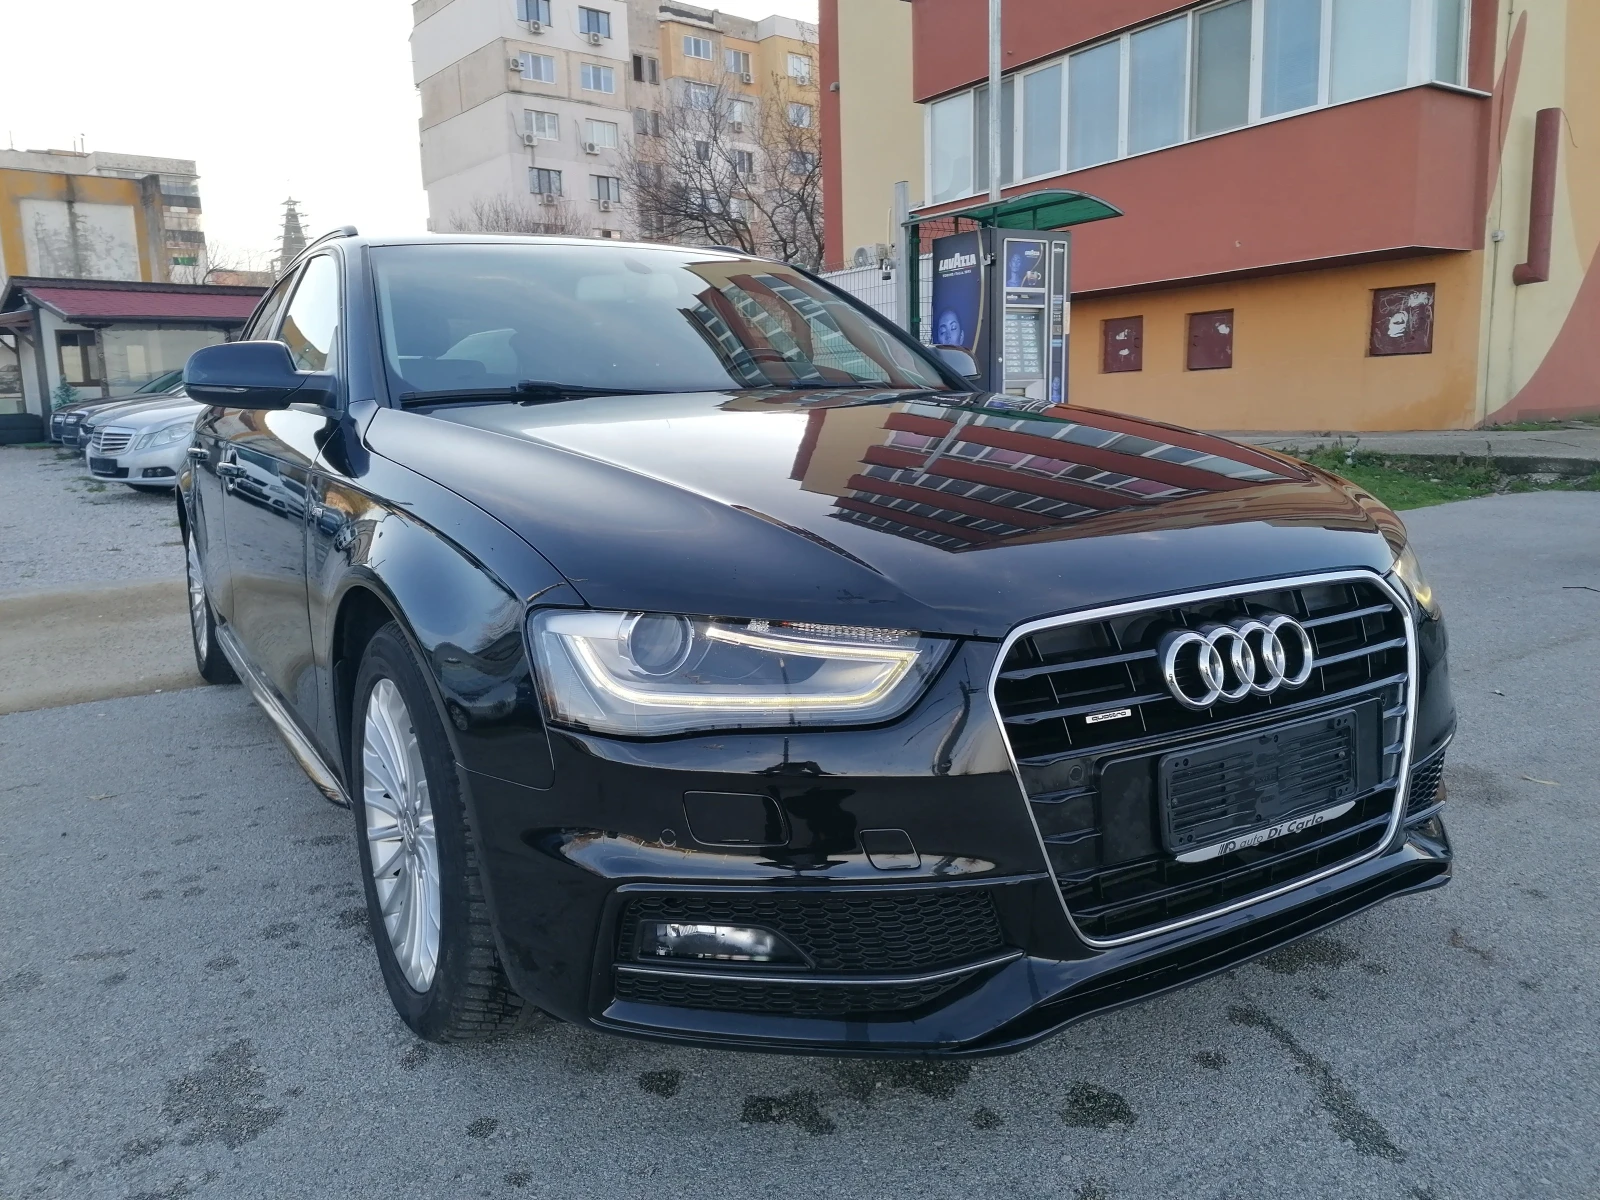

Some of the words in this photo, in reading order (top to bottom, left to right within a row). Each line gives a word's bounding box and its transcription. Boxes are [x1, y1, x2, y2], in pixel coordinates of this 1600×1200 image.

[938, 252, 977, 271] LAVAZZA
[1091, 711, 1127, 722] quattro
[1239, 834, 1264, 848] auto
[1267, 825, 1284, 840] Di
[1287, 814, 1324, 833] Carlo
